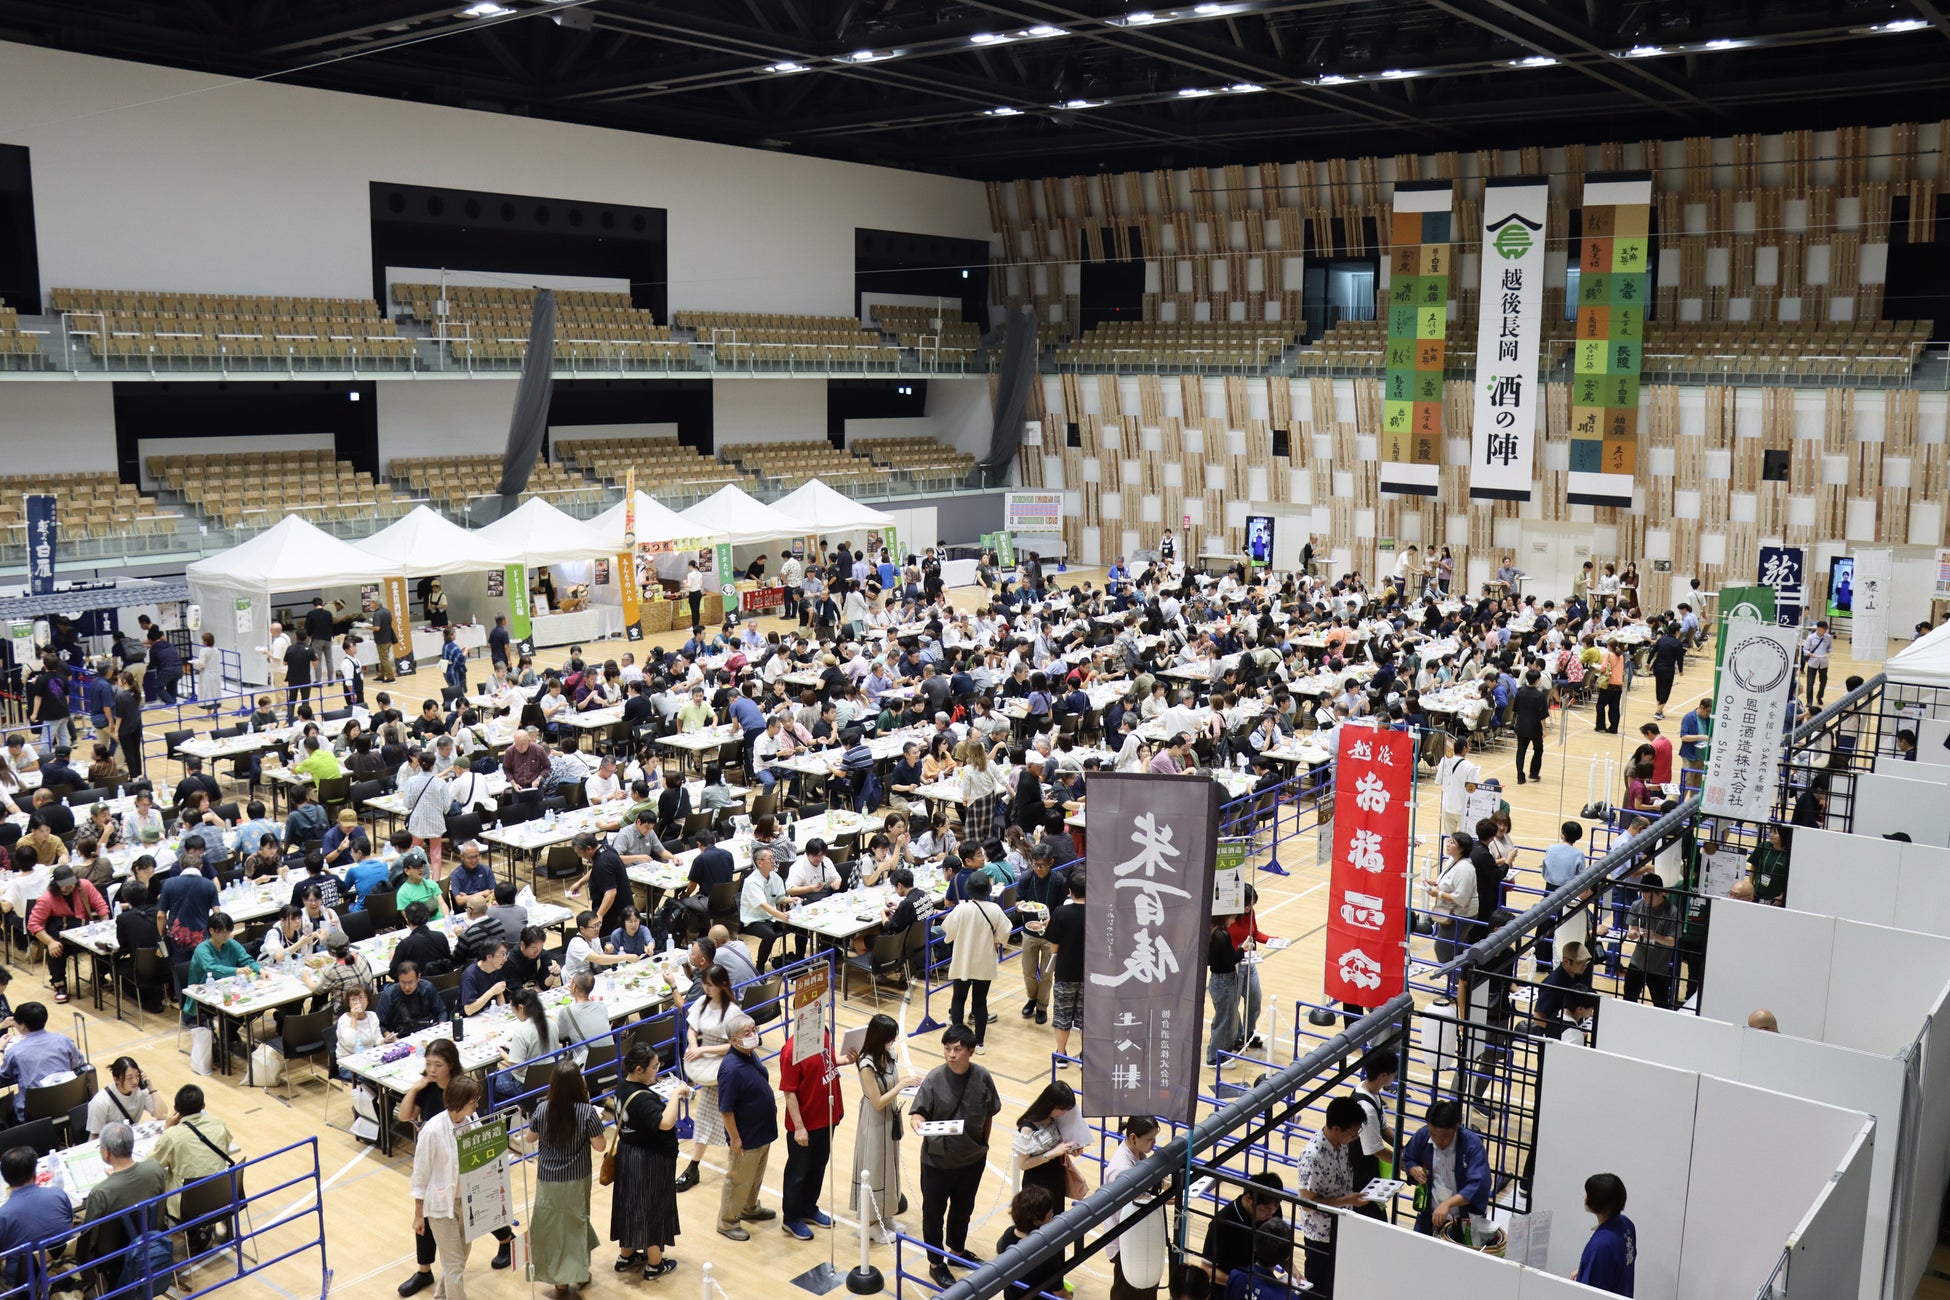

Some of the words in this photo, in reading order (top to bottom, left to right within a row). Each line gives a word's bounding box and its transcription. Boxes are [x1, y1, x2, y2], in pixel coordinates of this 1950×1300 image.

[1498, 268, 1523, 362] 越後長岡
[1486, 374, 1523, 466] 酒の陣
[1721, 695, 1735, 729] Onda
[1347, 738, 1394, 767] 越後
[1713, 740, 1728, 777] Shuzo
[1728, 697, 1759, 807] 恩田酒造株式会社
[1219, 859, 1237, 867] 入口
[801, 990, 818, 1004] 入口
[471, 1148, 495, 1166] 入口
